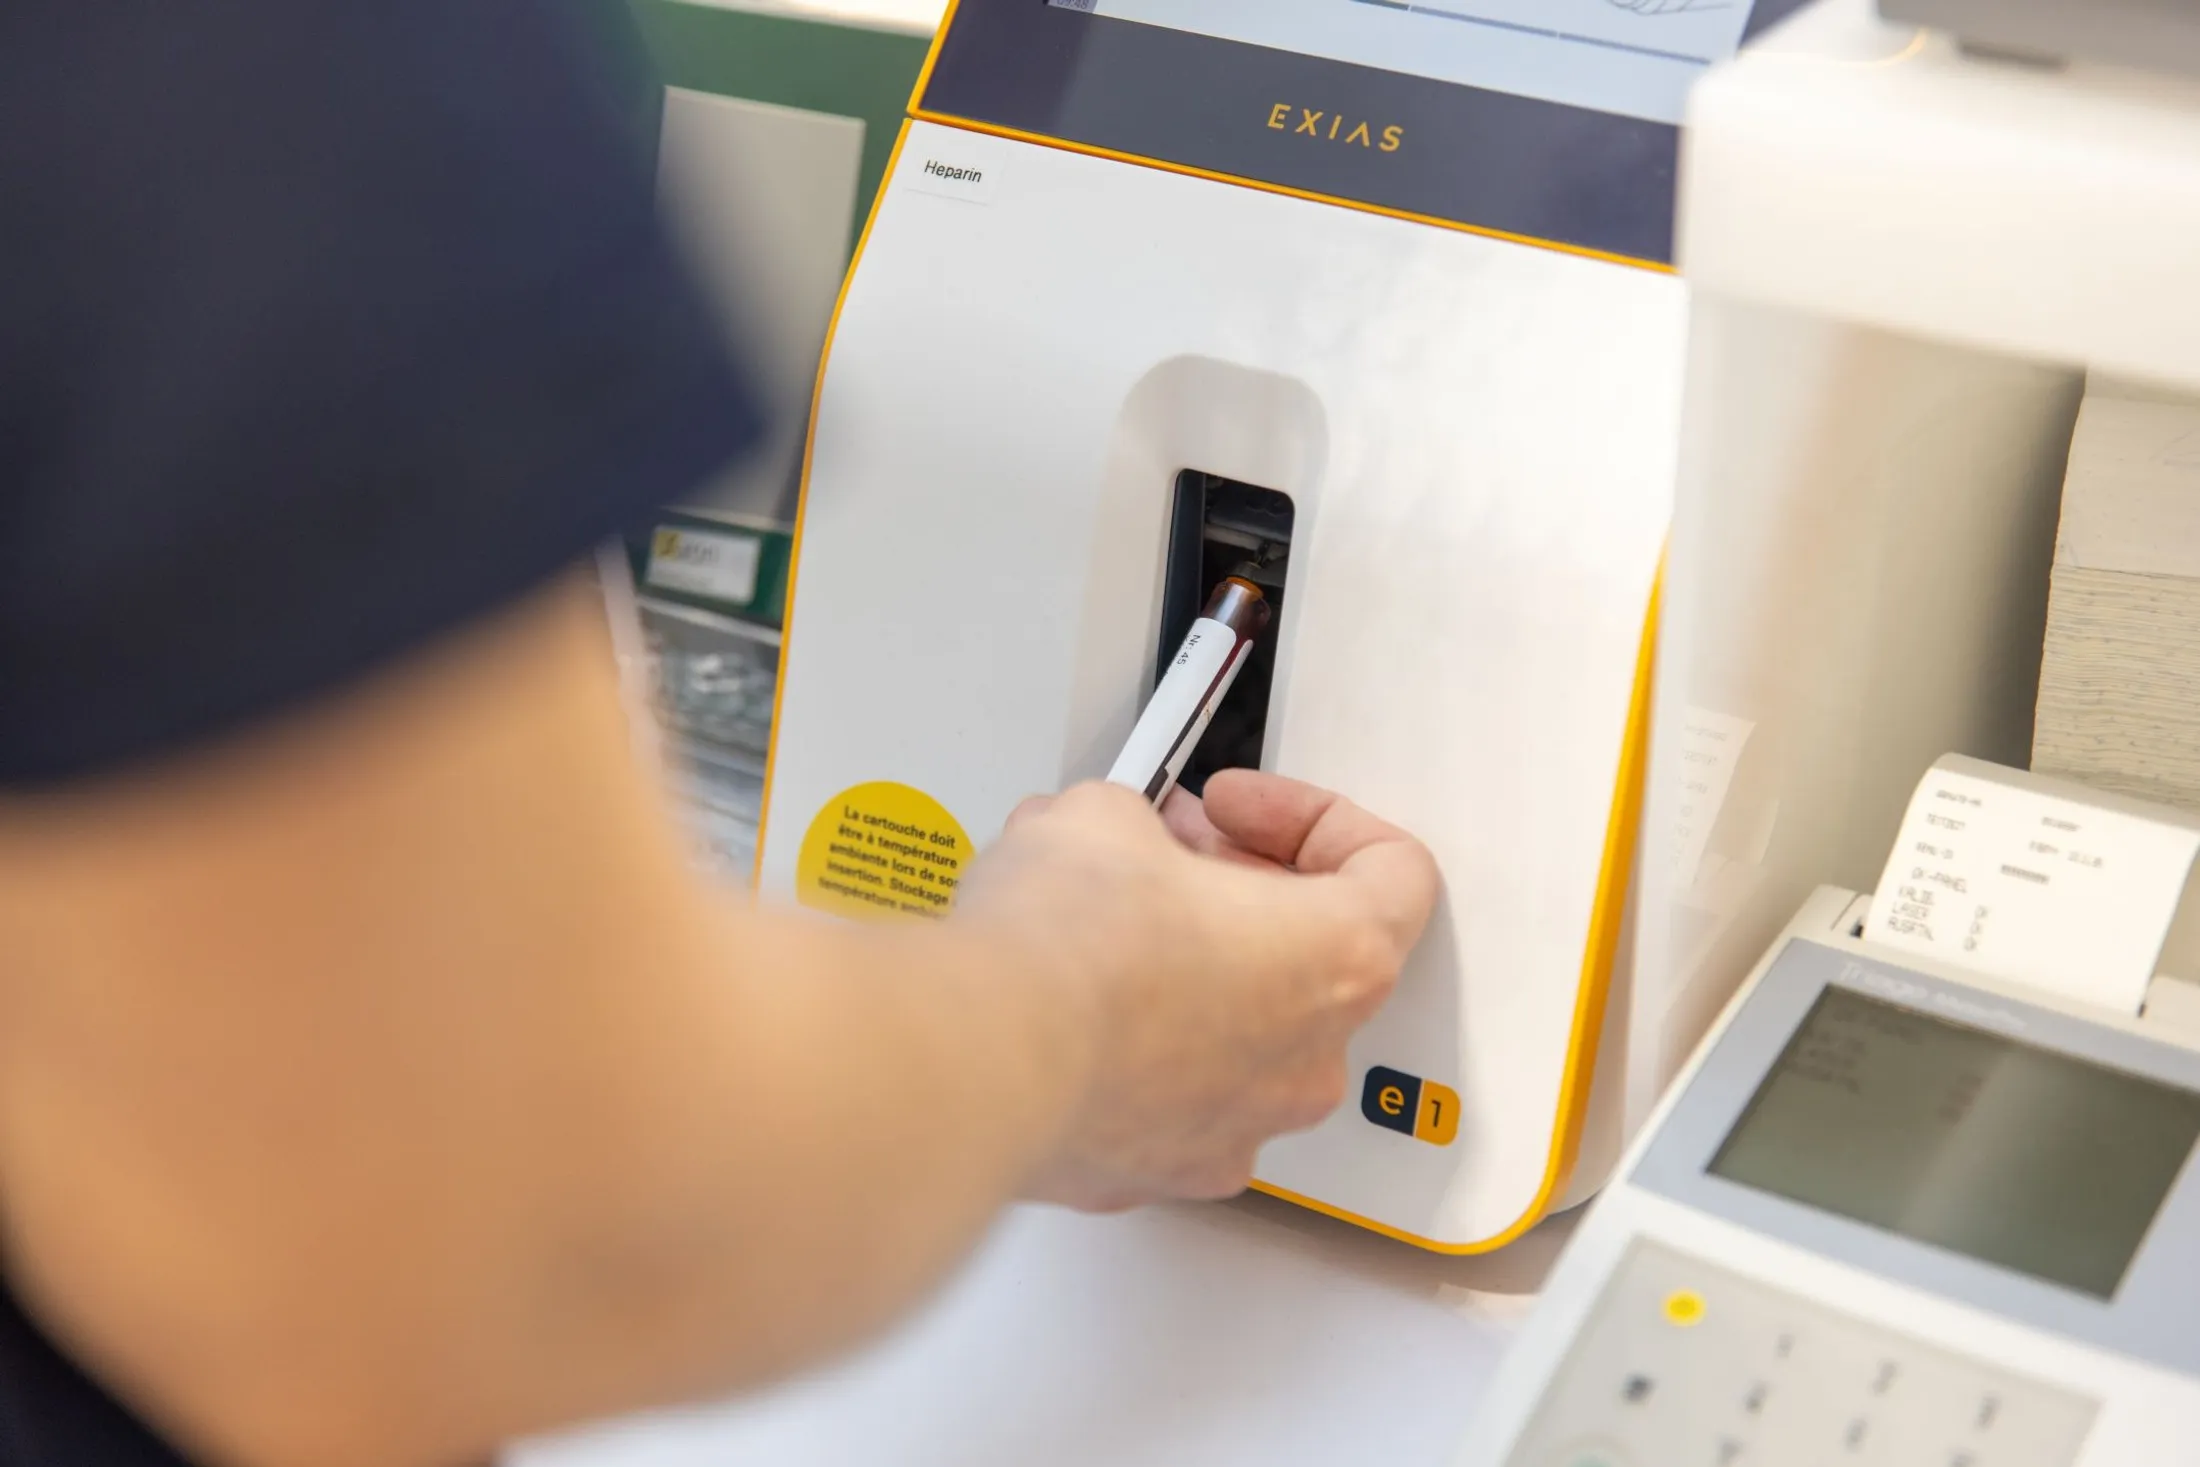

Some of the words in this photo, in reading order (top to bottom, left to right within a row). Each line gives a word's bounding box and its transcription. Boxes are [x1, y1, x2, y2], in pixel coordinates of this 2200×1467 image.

[1267, 103, 1404, 152] EXIAS
[924, 160, 982, 183] Heparin
[838, 823, 863, 841] être
[866, 832, 875, 845] à
[878, 836, 958, 869] température
[844, 805, 859, 820] La
[863, 813, 926, 840] cartouche
[929, 831, 956, 849] doit
[829, 843, 888, 867] ambiante
[892, 859, 916, 877] lors
[919, 868, 935, 882] de
[818, 877, 897, 909] température
[889, 877, 949, 906] Stockage
